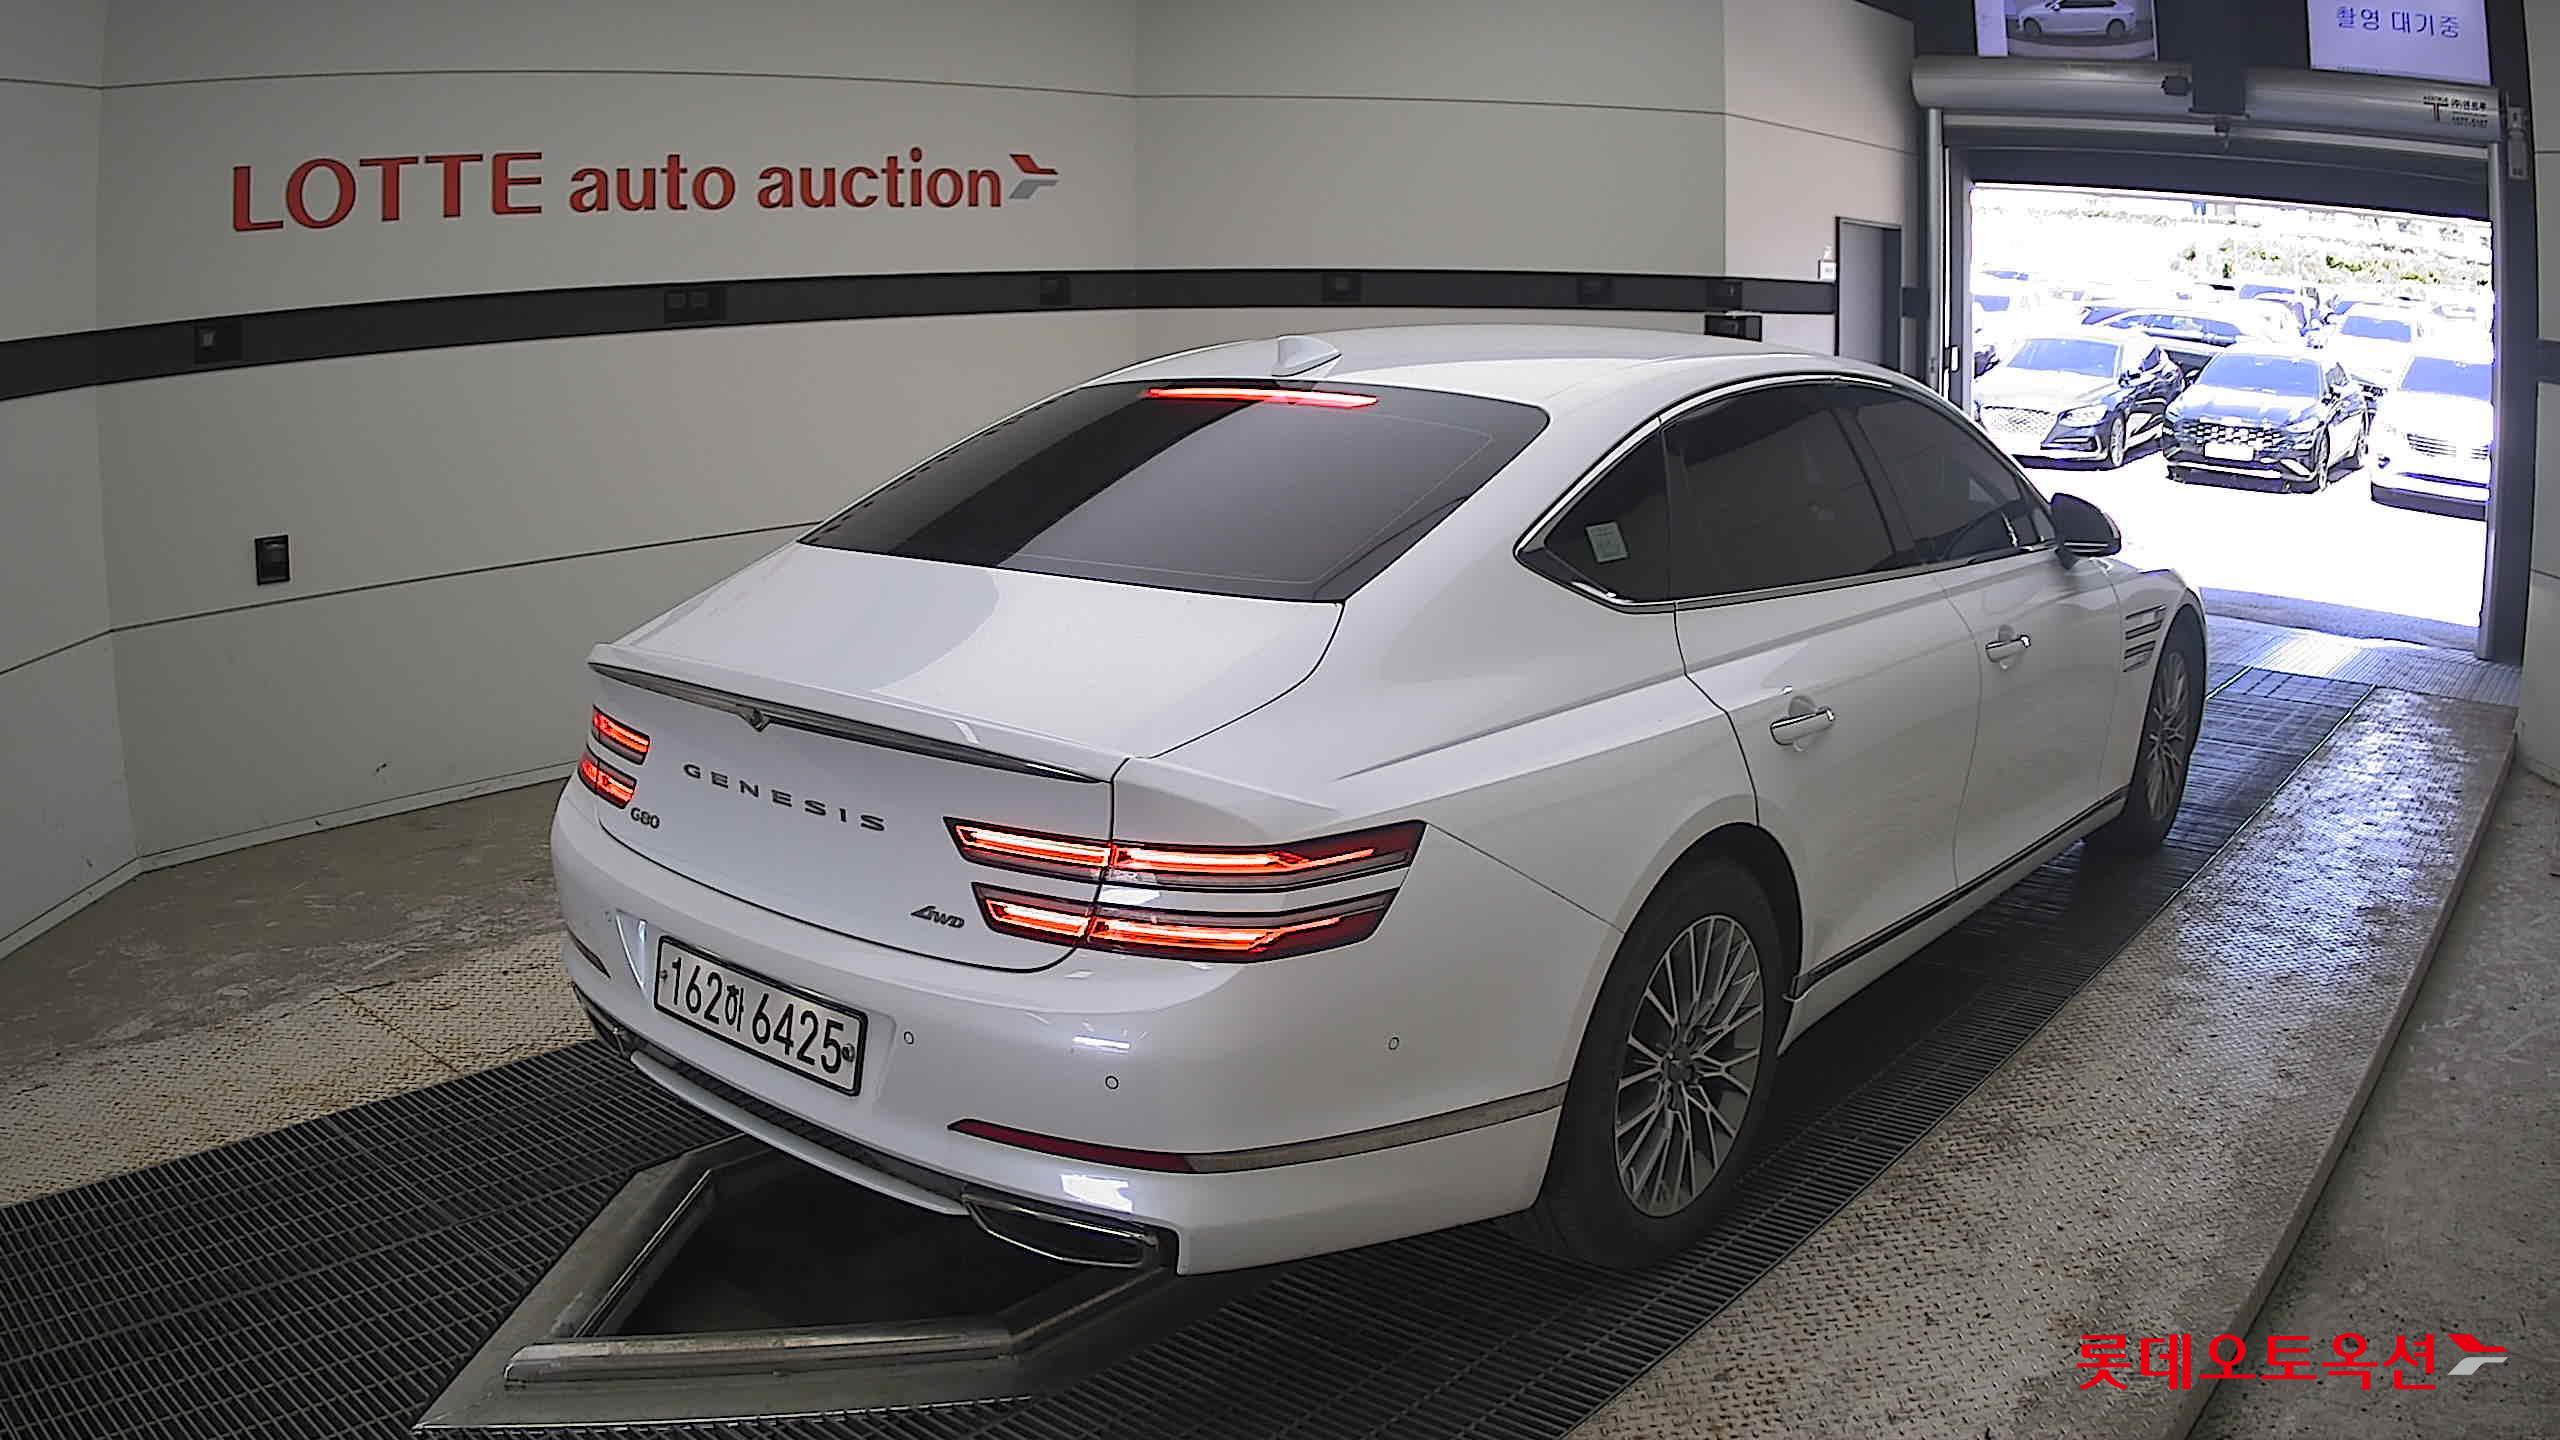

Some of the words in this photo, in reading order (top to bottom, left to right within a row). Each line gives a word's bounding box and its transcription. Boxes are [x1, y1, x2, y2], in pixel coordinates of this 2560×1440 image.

[2337, 6, 2380, 31] 촬영
[2391, 11, 2459, 39] 대기중
[232, 151, 542, 232] LOTTE
[568, 153, 736, 213] auto
[757, 146, 1002, 210] auction
[630, 807, 660, 829] G80
[683, 764, 885, 832] GENESIS
[672, 957, 744, 1032] 162하
[752, 993, 844, 1074] 6425
